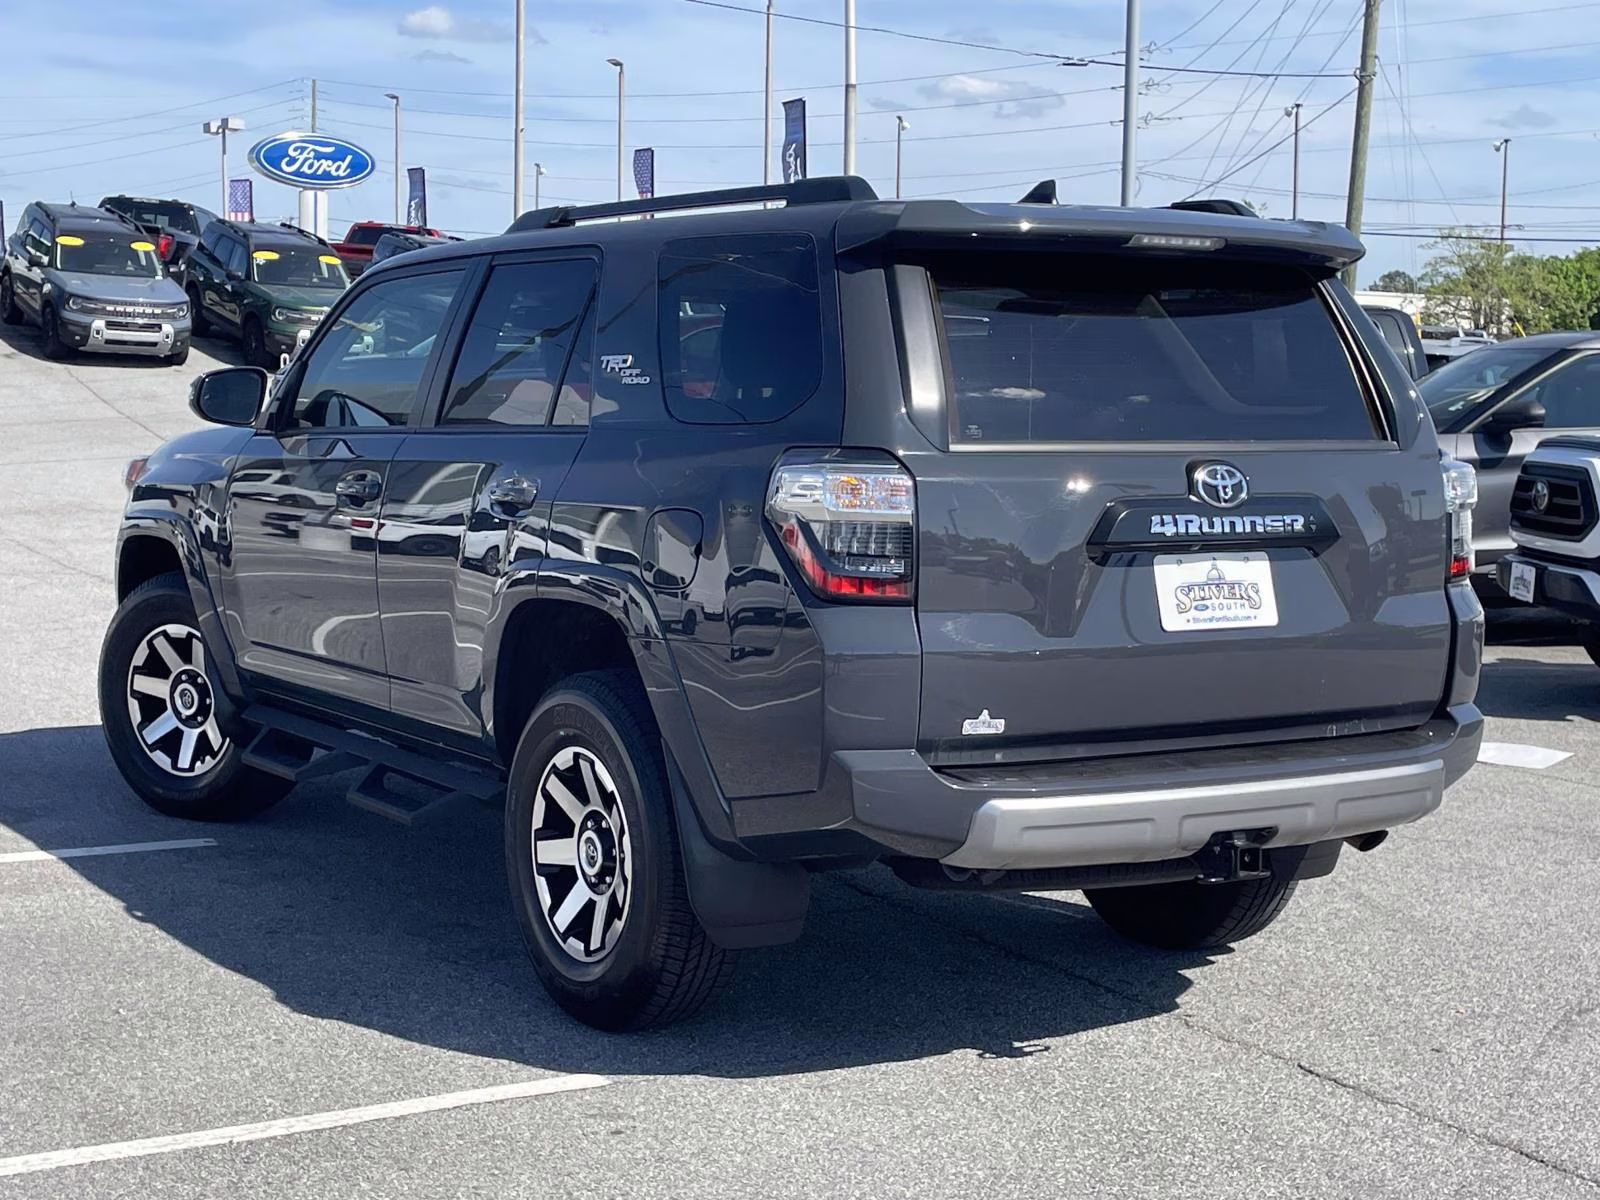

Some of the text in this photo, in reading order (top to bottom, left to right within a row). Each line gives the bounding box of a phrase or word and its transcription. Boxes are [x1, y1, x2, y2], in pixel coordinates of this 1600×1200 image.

[281, 142, 353, 176] Ford
[600, 354, 633, 372] TRD
[620, 368, 641, 376] OFF
[622, 376, 651, 384] ROAD
[1175, 582, 1262, 614] STIVERS
[1210, 602, 1246, 611] SOUTH
